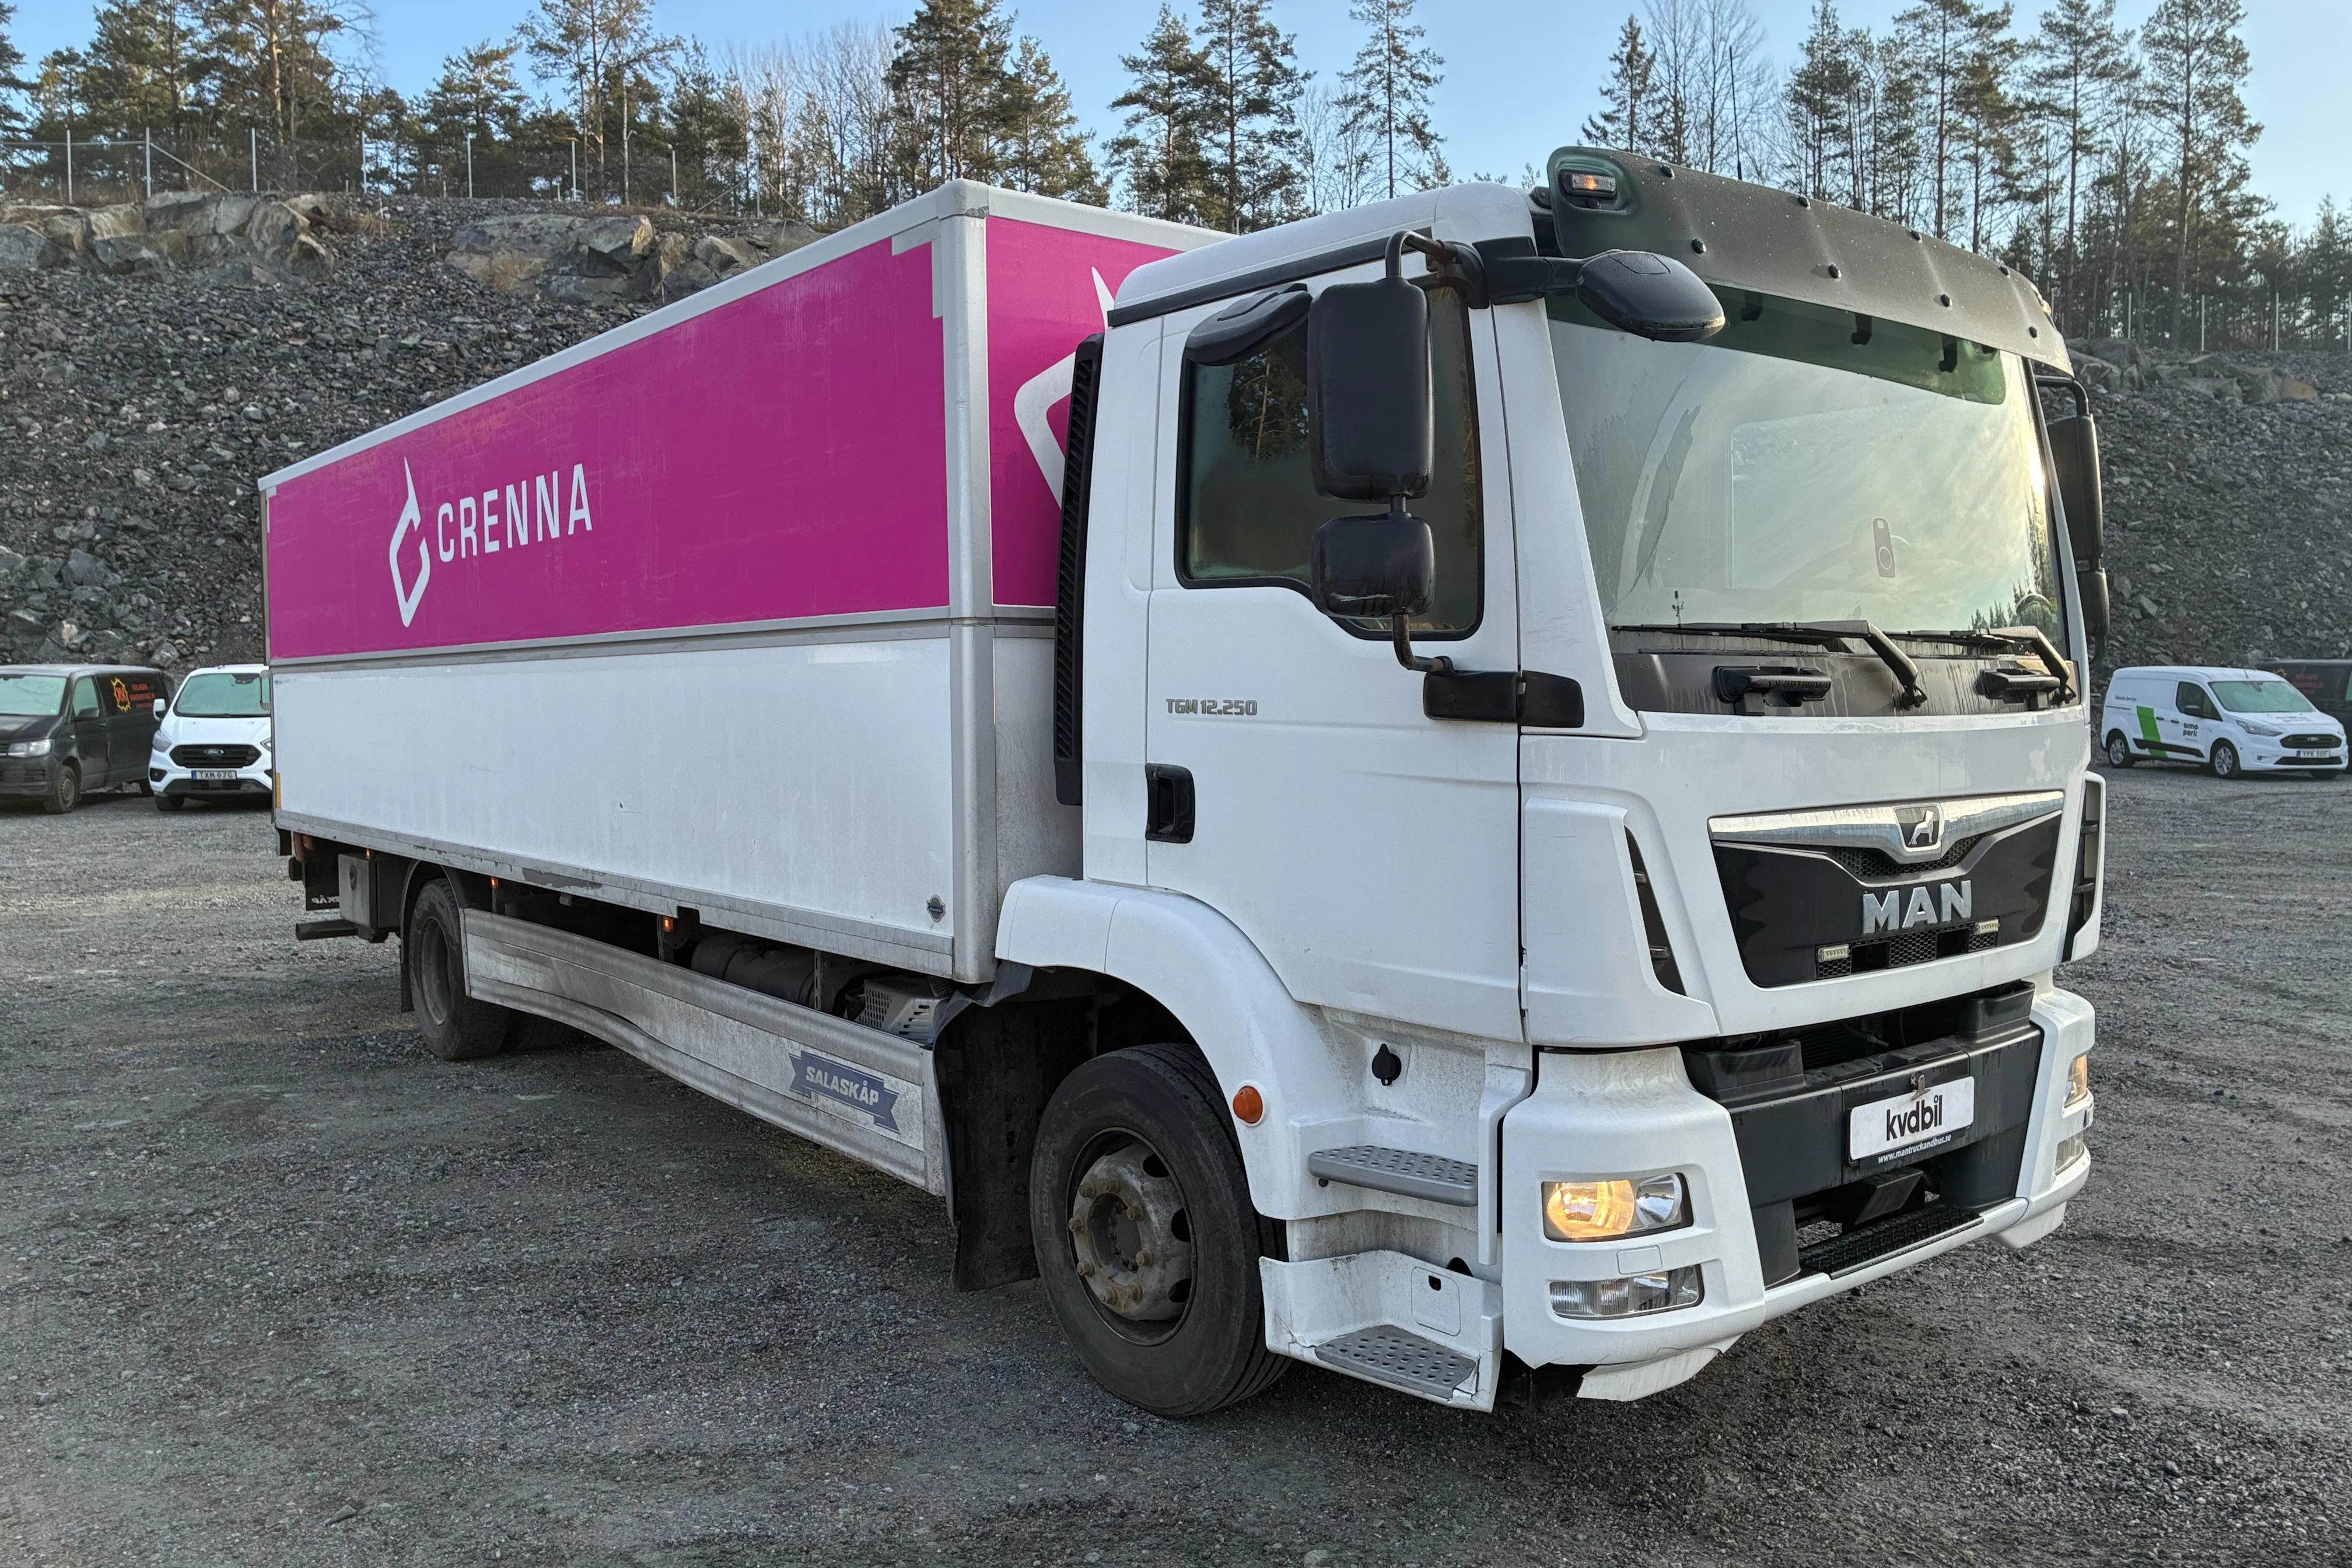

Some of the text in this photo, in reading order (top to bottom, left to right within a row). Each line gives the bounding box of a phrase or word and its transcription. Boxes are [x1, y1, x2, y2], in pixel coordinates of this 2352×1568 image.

[437, 463, 593, 563] CRENNA
[1166, 698, 1258, 716] TGM 12.250
[1862, 880, 1972, 935] MAN
[805, 1066, 880, 1106] SALASKÅP
[1886, 1094, 1943, 1142] kvdbil
[1878, 1133, 1952, 1164] www.mantruckandbus.se
